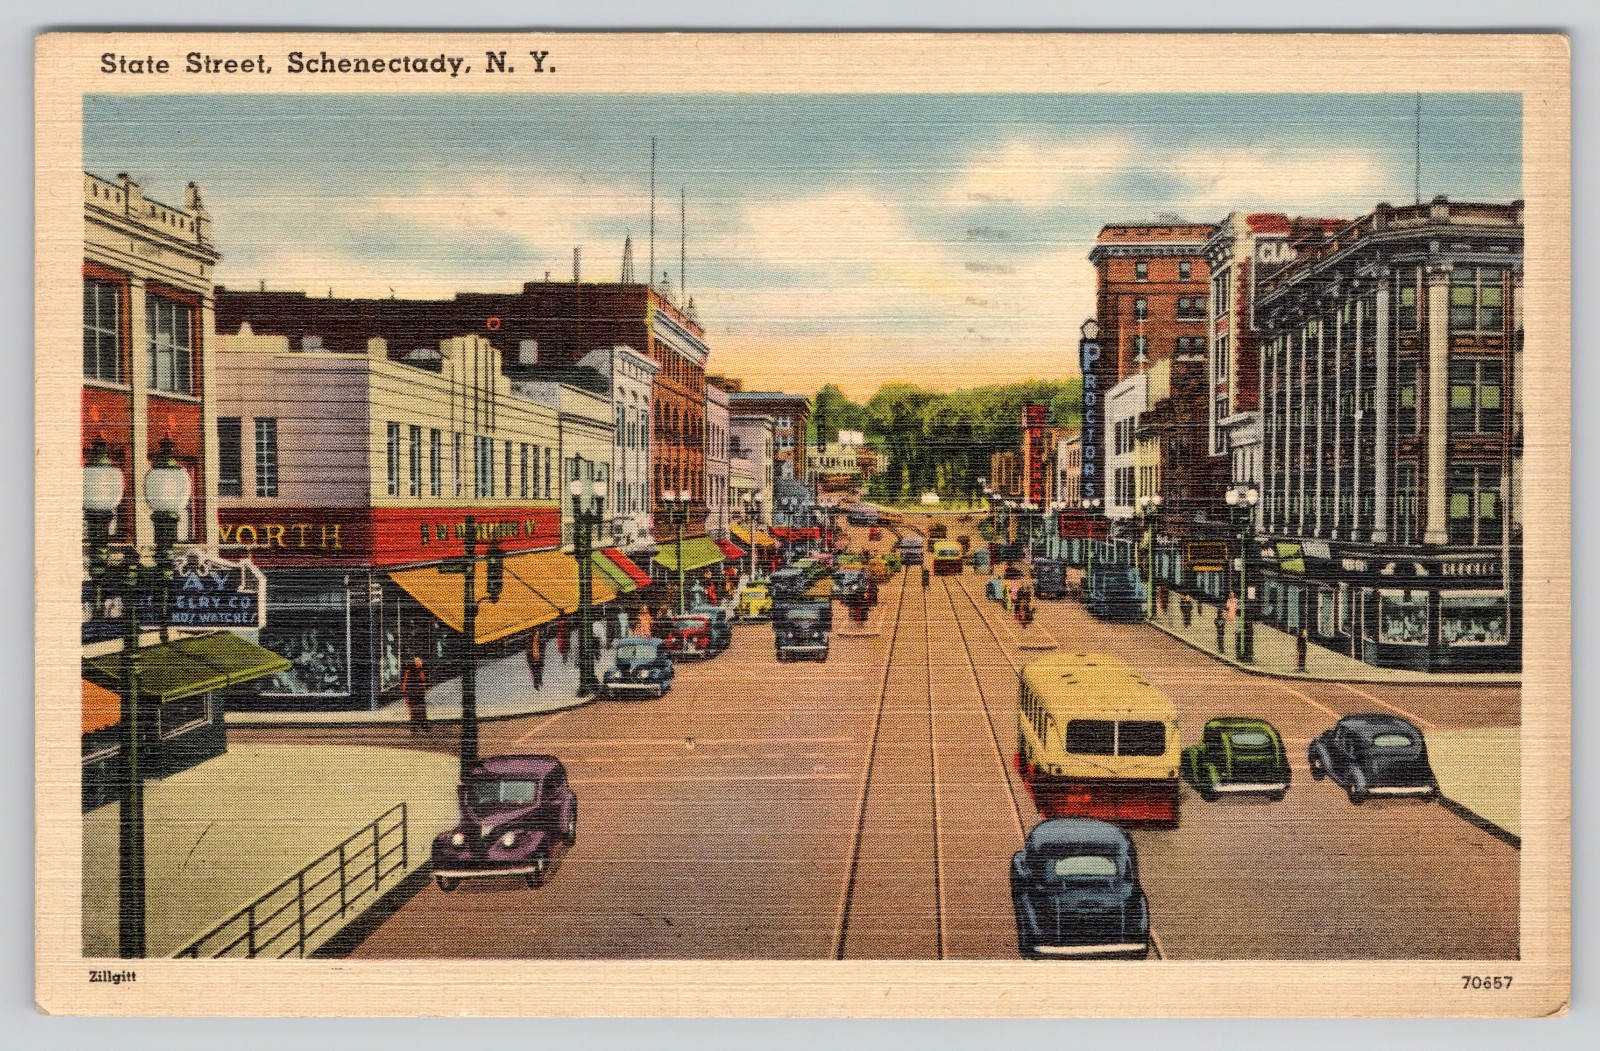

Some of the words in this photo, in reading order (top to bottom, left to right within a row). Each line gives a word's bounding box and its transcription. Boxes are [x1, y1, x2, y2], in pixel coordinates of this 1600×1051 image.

[100, 52, 170, 74] State
[186, 51, 273, 75] Street,
[287, 51, 472, 78] Schenectady,
[485, 52, 515, 74] N.
[529, 51, 557, 74] Y.
[1082, 340, 1101, 498] PROCTORS
[183, 572, 231, 591] AY
[89, 970, 136, 985] Zillgitt
[1461, 975, 1514, 990] 70657
